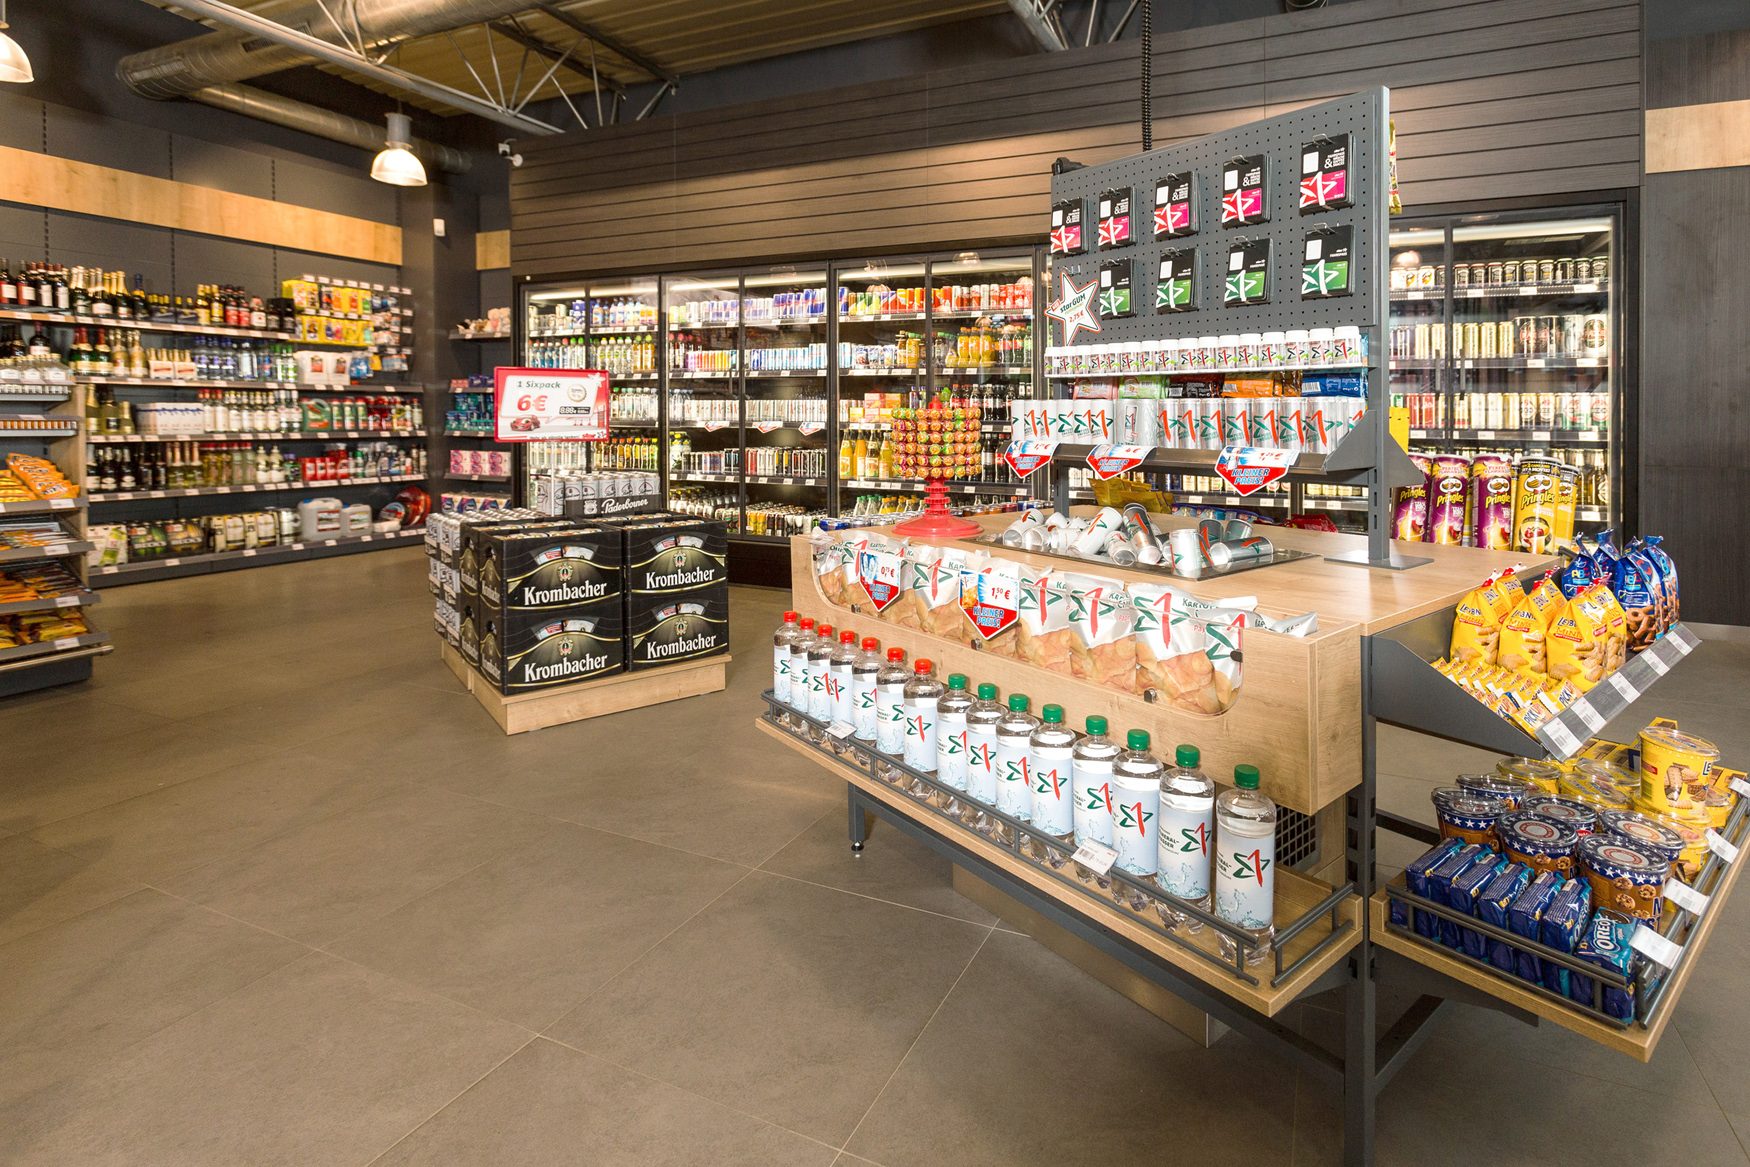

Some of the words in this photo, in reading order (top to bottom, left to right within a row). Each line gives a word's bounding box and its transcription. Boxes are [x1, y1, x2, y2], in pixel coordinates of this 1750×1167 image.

[526, 381, 560, 389] Sixpack
[1231, 468, 1270, 477] KLEINER
[1234, 476, 1264, 485] PREIS!
[1400, 487, 1426, 502] Pringles
[1436, 492, 1464, 507] Pringles
[1486, 492, 1511, 508] Pringle
[1521, 491, 1555, 509] Pringles
[601, 498, 648, 514] Paderborner
[645, 566, 715, 589] Krombacher
[890, 568, 895, 577] €
[1572, 567, 1589, 579] ABC
[524, 580, 607, 605] Krombacher
[869, 584, 890, 593] KLEINER
[991, 587, 1003, 599] 1,50
[1004, 590, 1011, 600] €
[872, 592, 888, 602] PREIS!
[973, 606, 1004, 619] KLEINER
[1460, 604, 1481, 615] LEIBN
[977, 616, 1001, 628] PREIS!
[646, 633, 716, 659] Krombacher
[524, 650, 608, 682] Krombacher
[1160, 831, 1179, 844] NERAL-
[1597, 920, 1615, 951] OREO
